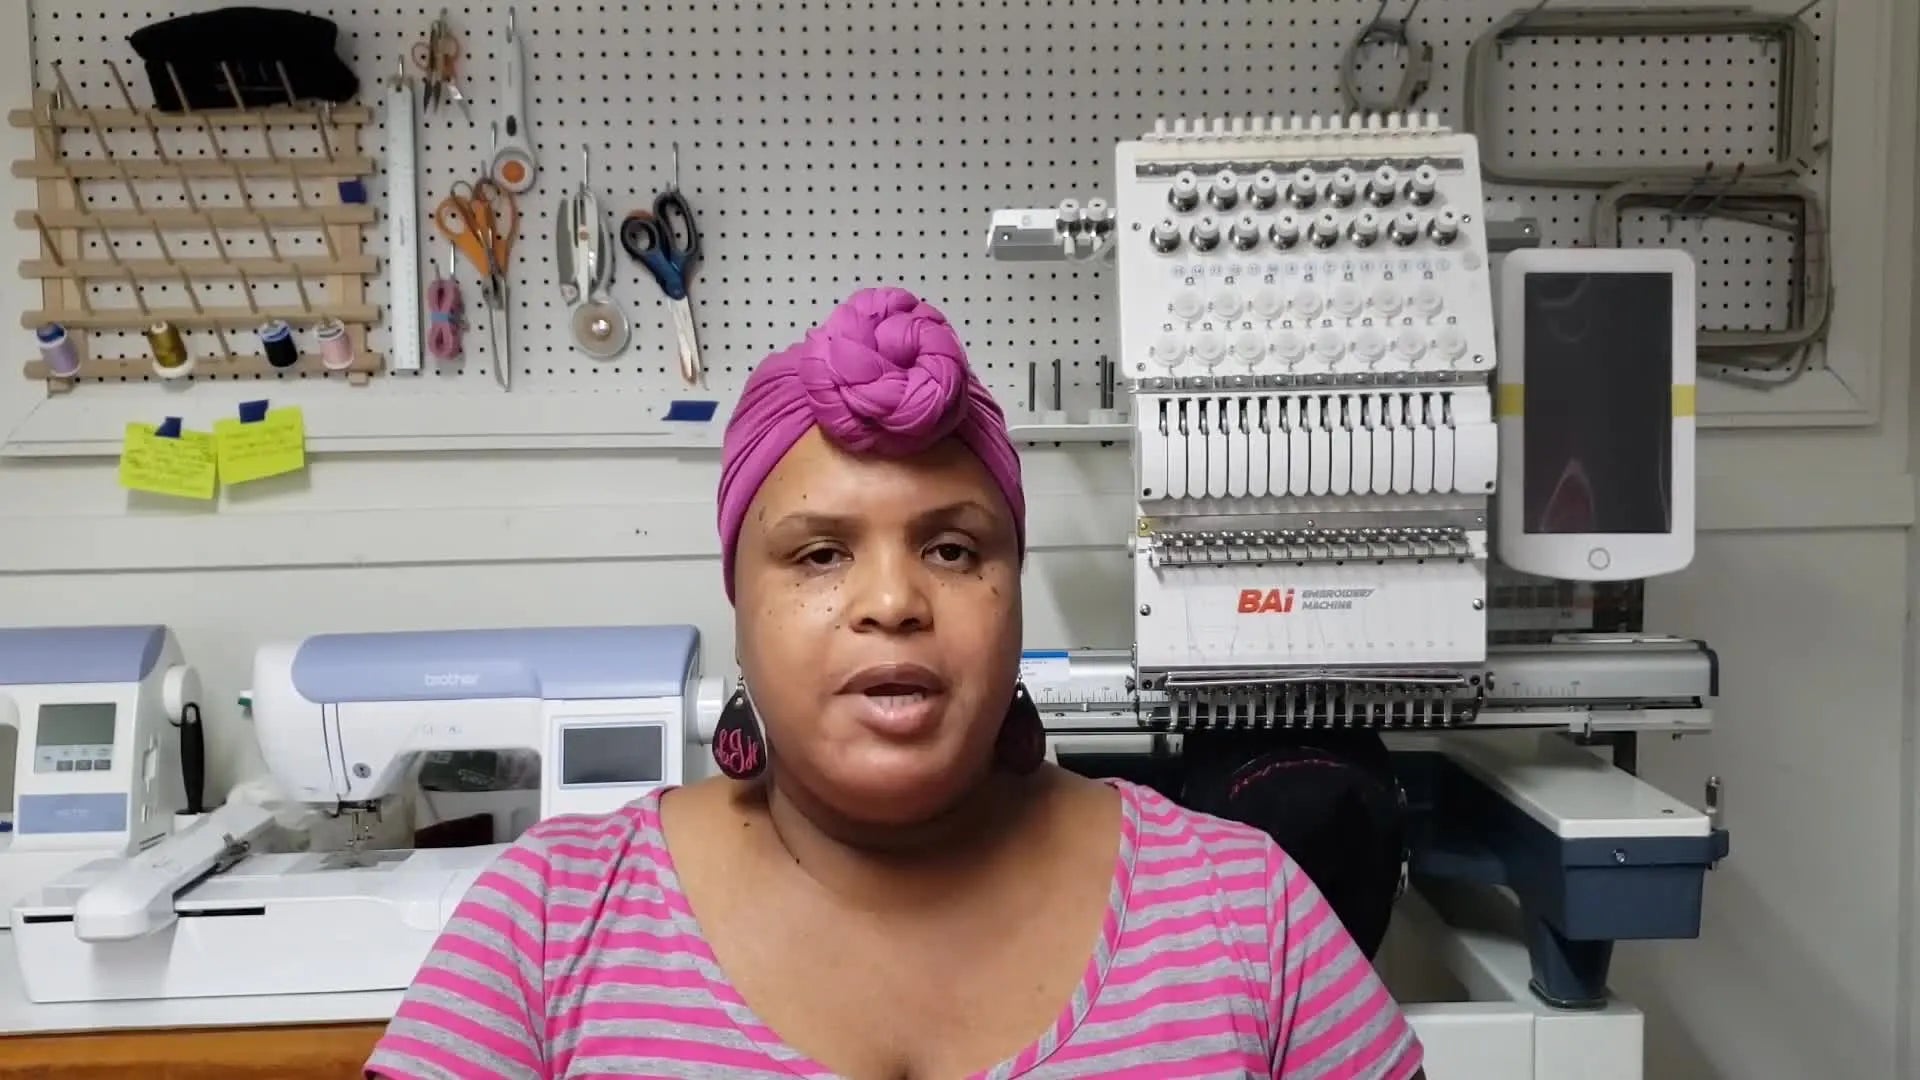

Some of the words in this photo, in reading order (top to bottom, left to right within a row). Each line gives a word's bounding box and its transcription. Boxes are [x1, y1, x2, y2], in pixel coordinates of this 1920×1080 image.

[1302, 588, 1376, 598] EMBROIDERY
[1237, 588, 1295, 613] BAi
[1301, 600, 1353, 610] MACHINE
[424, 671, 480, 687] brother
